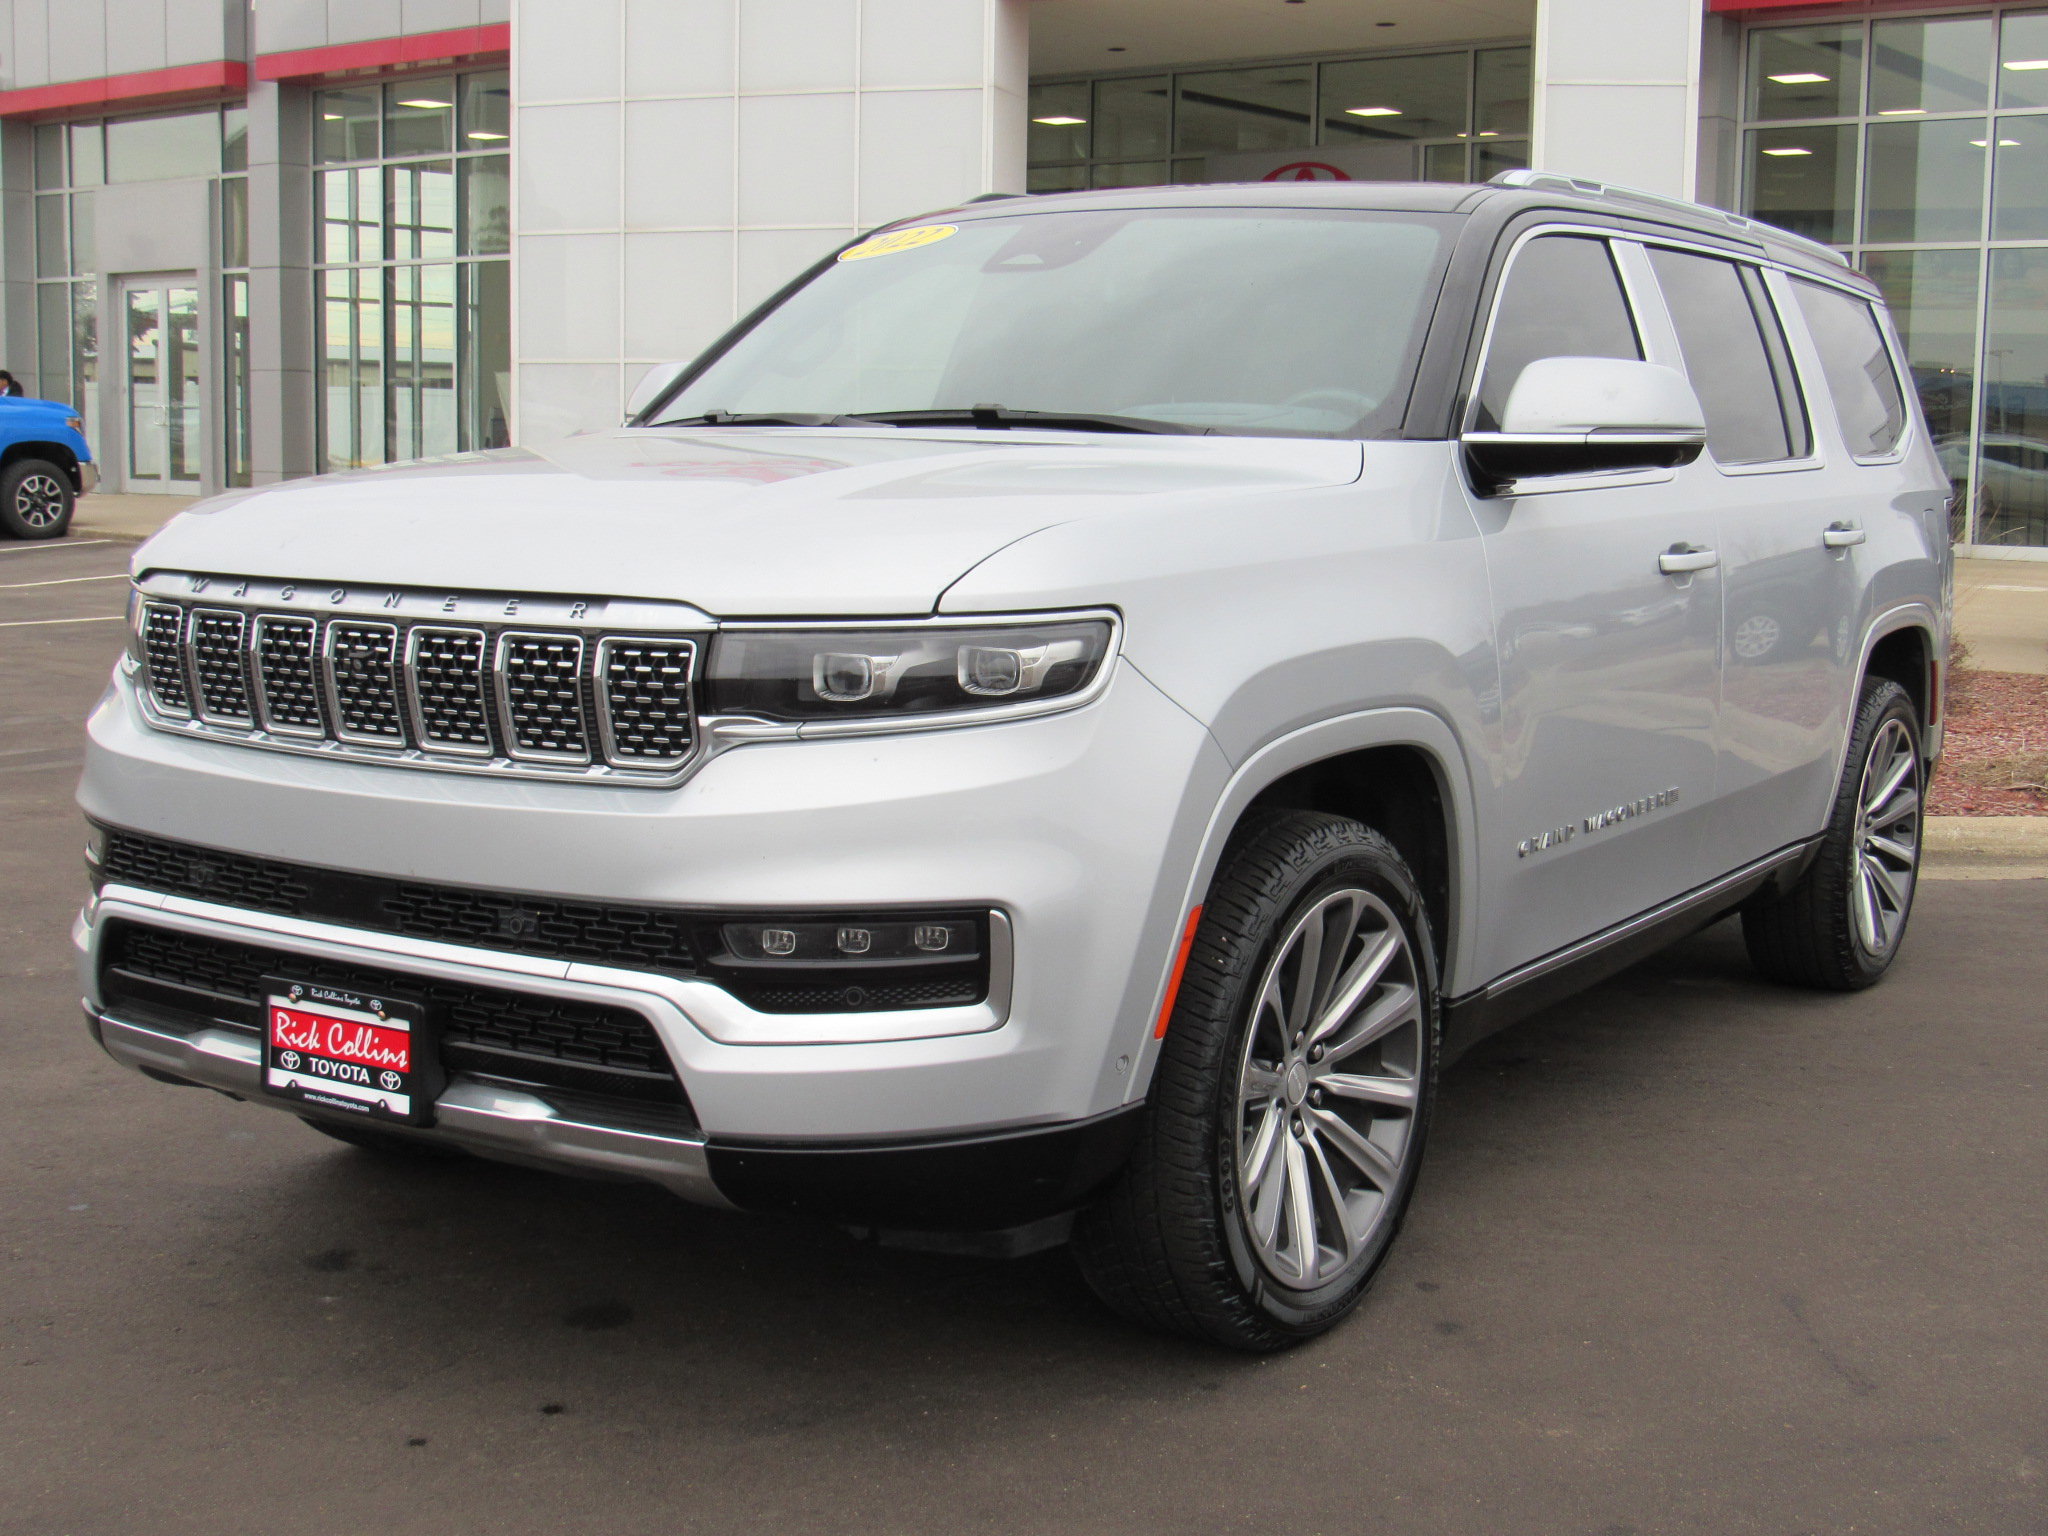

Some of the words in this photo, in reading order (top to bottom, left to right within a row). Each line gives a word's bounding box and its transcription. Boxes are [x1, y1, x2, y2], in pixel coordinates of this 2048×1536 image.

[852, 227, 945, 256] 2022
[191, 578, 588, 618] WAGONEER
[1518, 824, 1575, 858] GRAND
[311, 988, 323, 998] Rick
[324, 990, 344, 1002] Collins
[344, 993, 361, 1006] Toyota
[276, 1011, 320, 1050] Rick
[328, 1023, 408, 1068] Collins
[309, 1057, 370, 1084] TOYOTA
